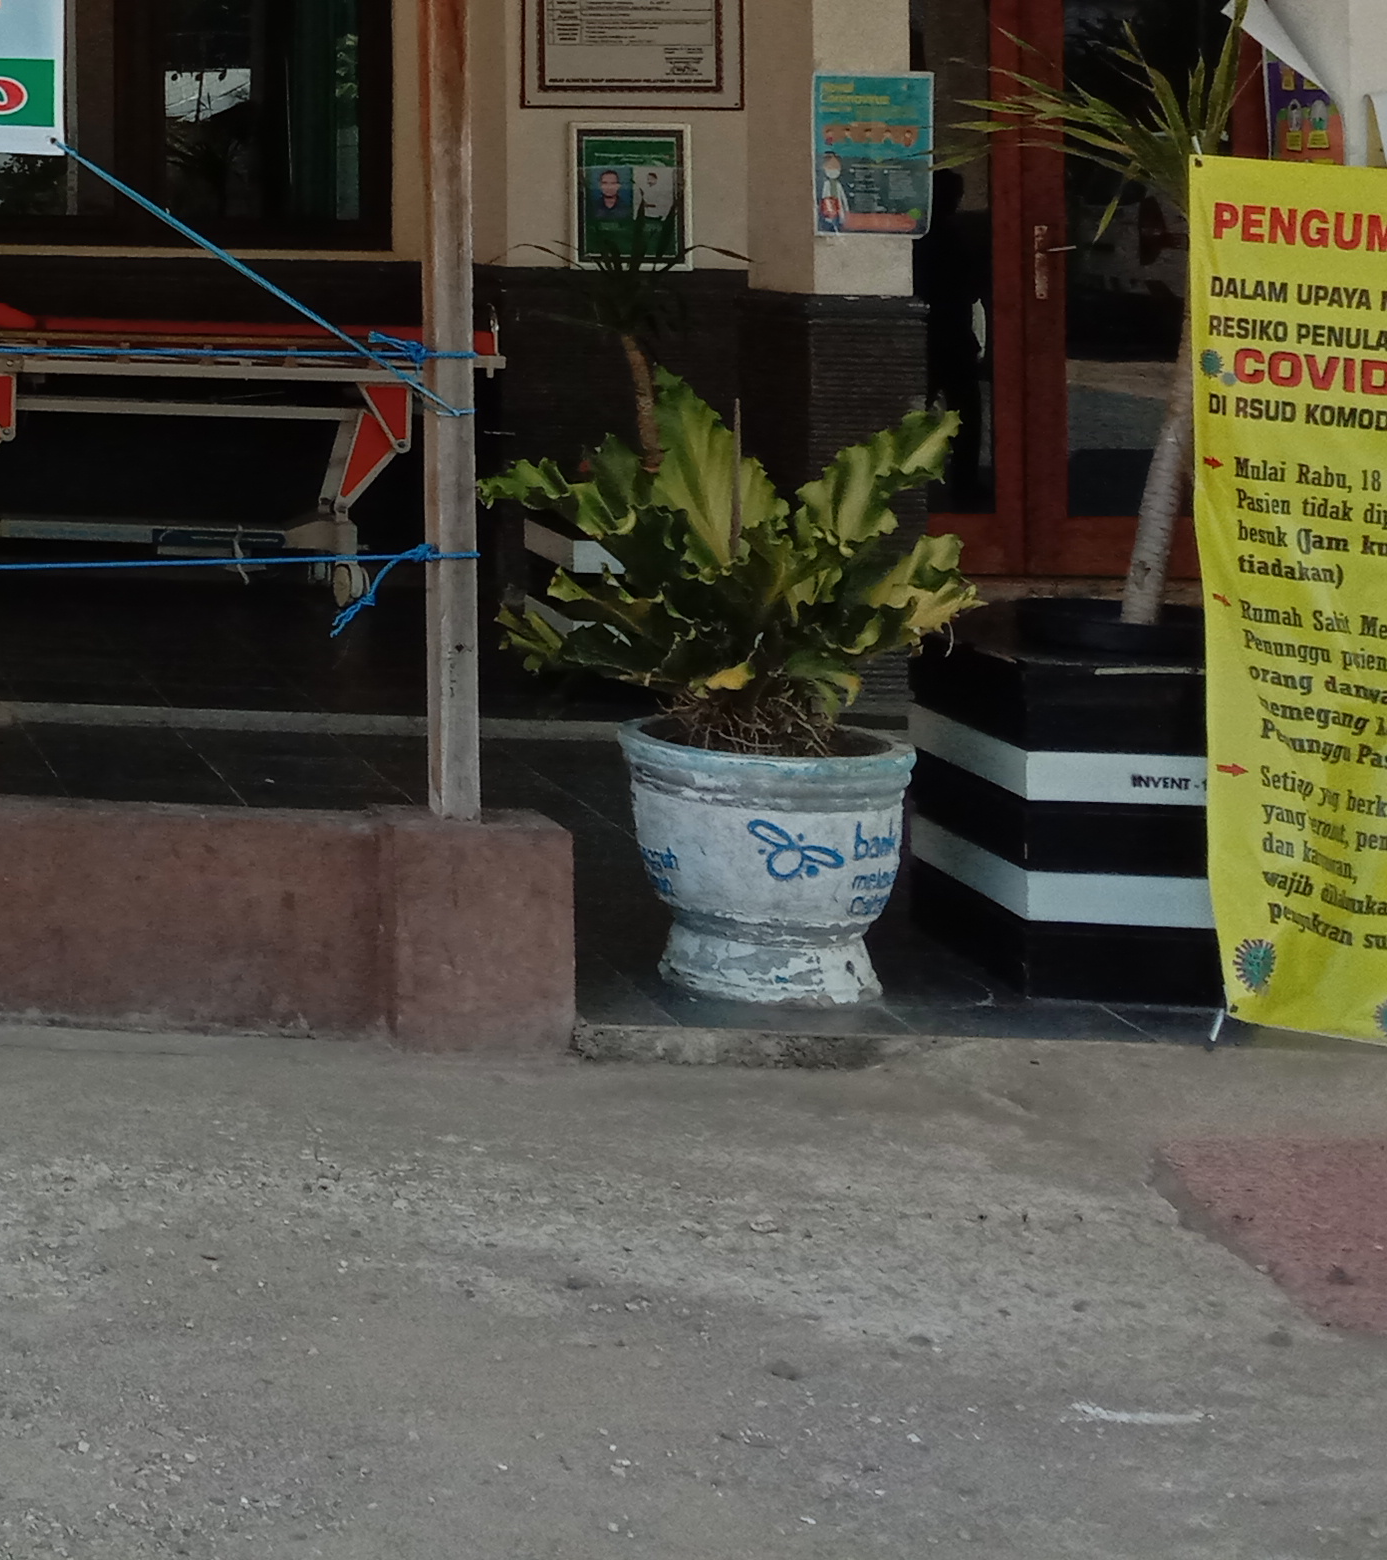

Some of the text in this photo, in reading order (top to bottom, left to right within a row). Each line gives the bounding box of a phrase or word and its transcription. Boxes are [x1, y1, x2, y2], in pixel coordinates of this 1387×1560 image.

[1211, 276, 1288, 303] DALAM
[1297, 284, 1372, 310] UPAYA
[1209, 315, 1288, 342] RESIKO
[1209, 393, 1226, 416] DI
[1235, 397, 1296, 423] RSUD
[1234, 456, 1382, 493] Mulai Rabu, 18
[1236, 488, 1291, 515] Pasien
[1302, 496, 1353, 521] tidak
[1237, 519, 1288, 547] besuk
[1297, 528, 1350, 555] (Jam
[1238, 554, 1344, 589] tiadakan)
[1239, 599, 1303, 628] Rumah
[1242, 629, 1332, 665] Penunggu
[1249, 666, 1314, 695] orang
[1262, 804, 1306, 831] yang
[1262, 831, 1294, 858] dan
